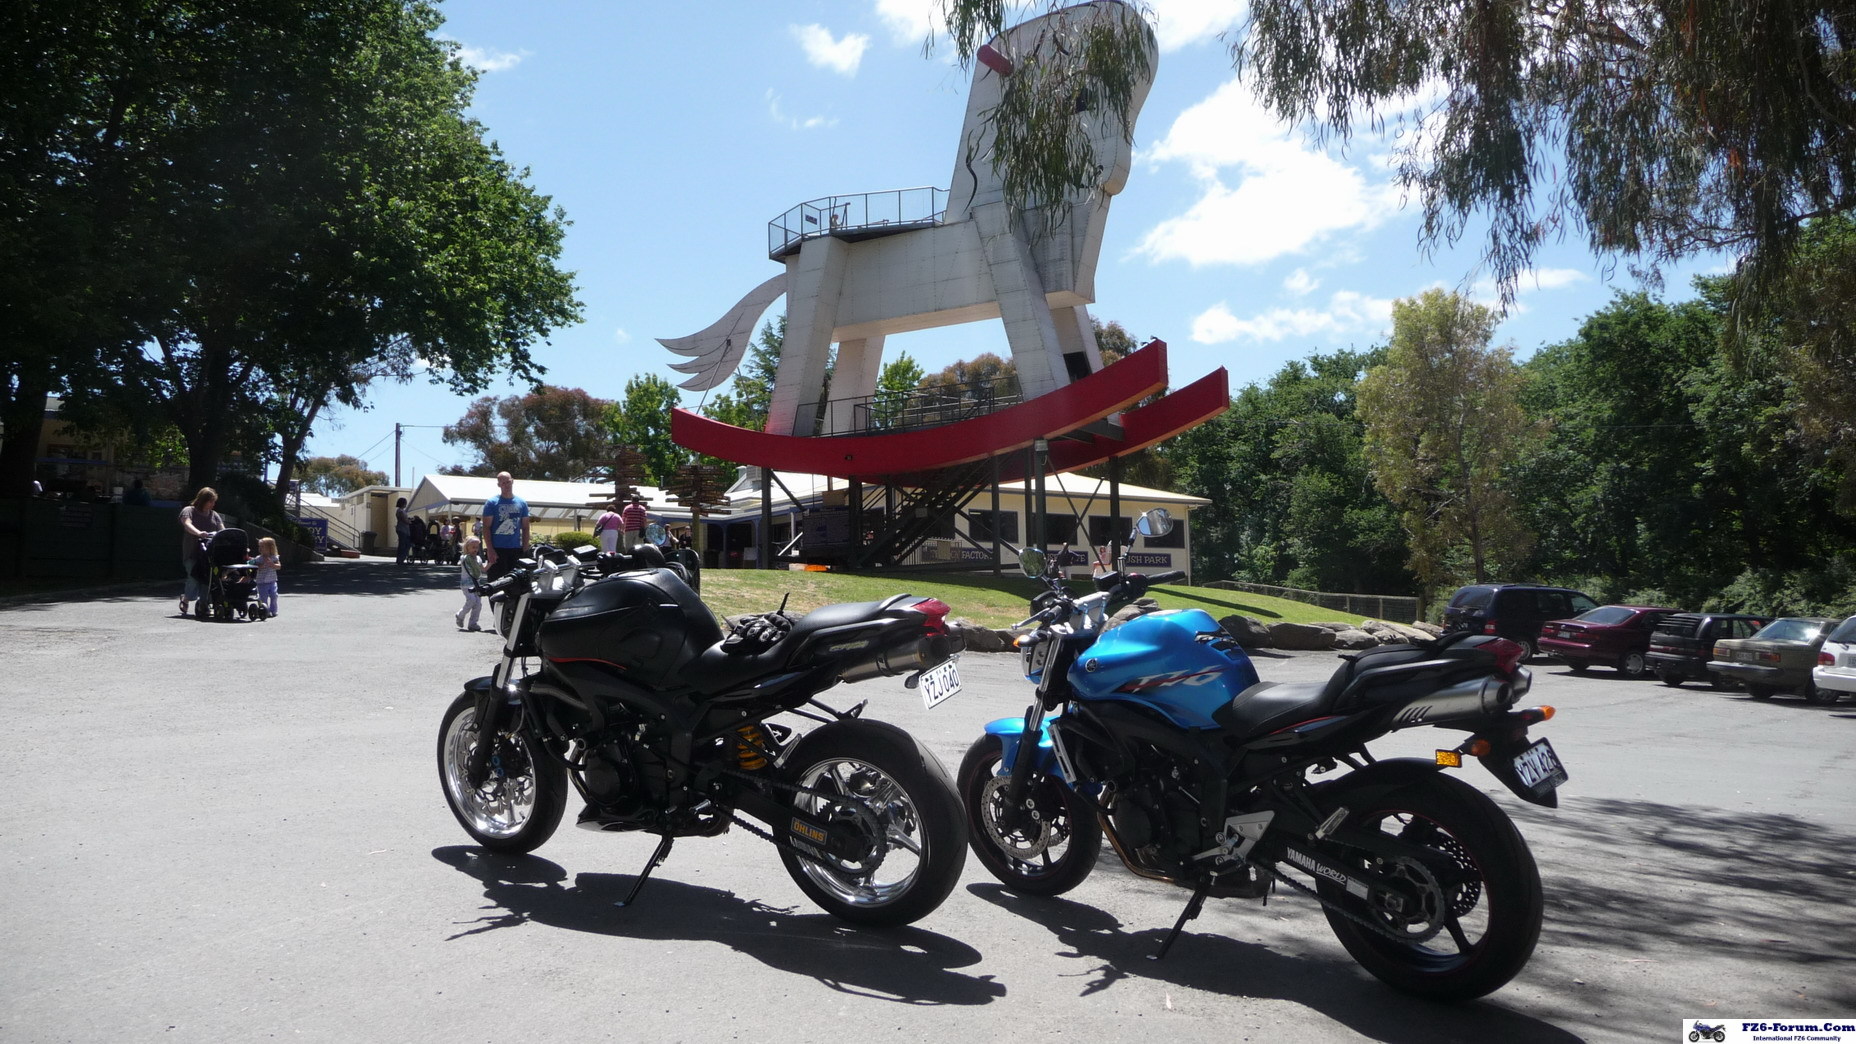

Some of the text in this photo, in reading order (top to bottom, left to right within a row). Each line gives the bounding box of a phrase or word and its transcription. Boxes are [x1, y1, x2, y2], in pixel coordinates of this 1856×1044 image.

[1144, 556, 1168, 564] PARK
[1286, 846, 1347, 886] YAMAHA WORLD
